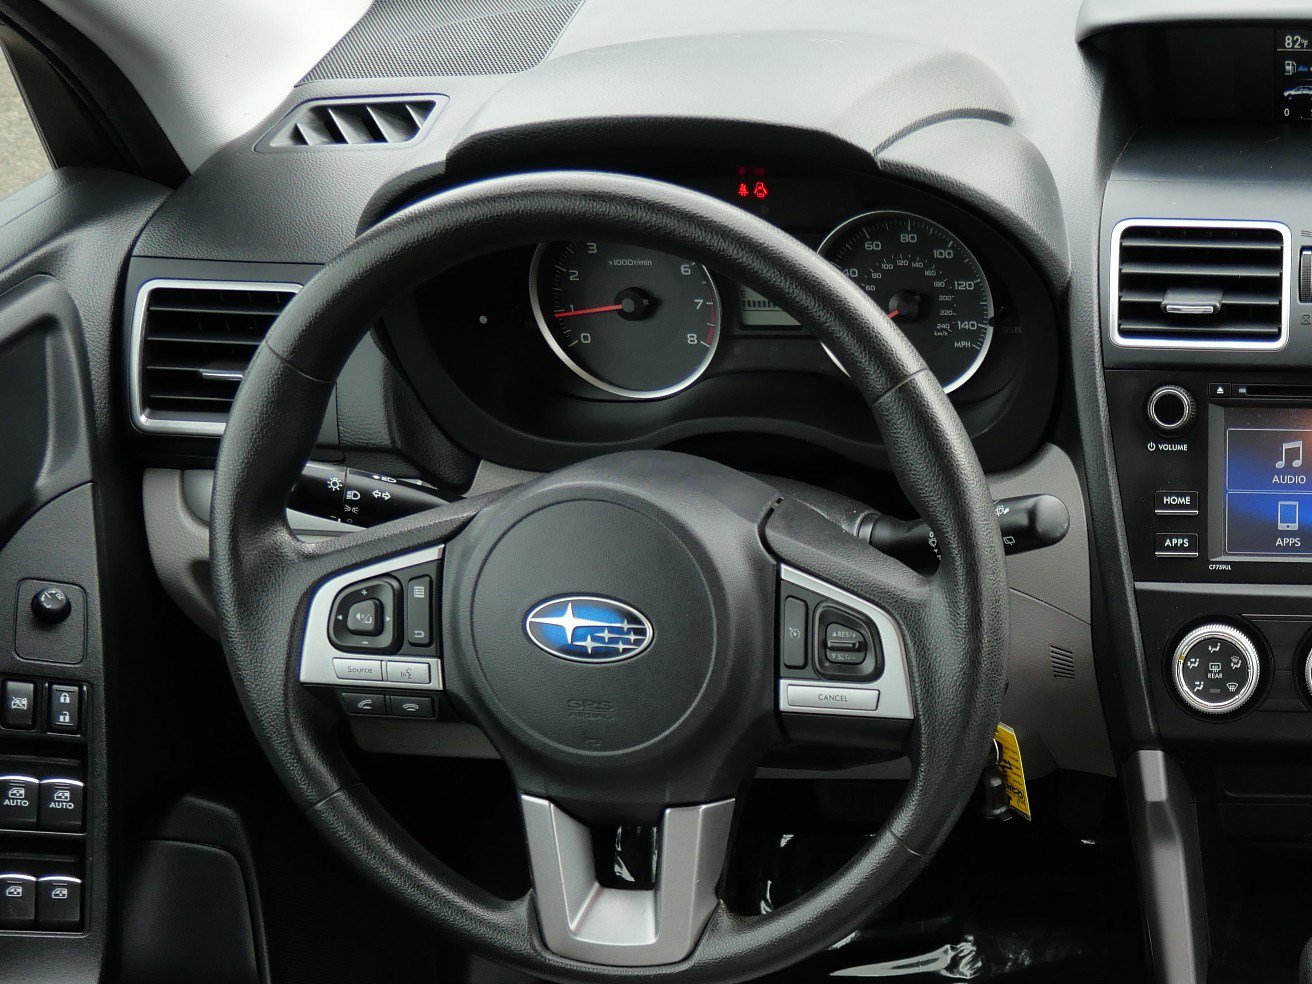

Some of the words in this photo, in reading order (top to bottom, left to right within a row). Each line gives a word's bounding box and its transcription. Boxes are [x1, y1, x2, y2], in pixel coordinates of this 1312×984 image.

[1283, 108, 1290, 117] 0
[900, 233, 918, 243] 80
[586, 242, 598, 254] 3
[864, 241, 882, 251] 60
[933, 250, 954, 259] 100
[680, 264, 691, 275] 6
[924, 269, 937, 277] 160
[568, 269, 580, 281] 2
[865, 284, 876, 292] 60
[954, 280, 974, 291] 120
[694, 299, 705, 310] 7
[957, 320, 978, 330] 140
[580, 332, 591, 344] 0
[686, 333, 698, 345] 8
[954, 341, 972, 349] MPH
[1272, 475, 1307, 484] AUDIO
[1163, 496, 1191, 505] HOME
[1164, 538, 1189, 547] APPS
[1275, 537, 1301, 547] APPS
[347, 665, 373, 674] Source
[818, 693, 849, 702] CANCEL
[3, 798, 29, 807] AUTO
[49, 802, 75, 810] AUTO
